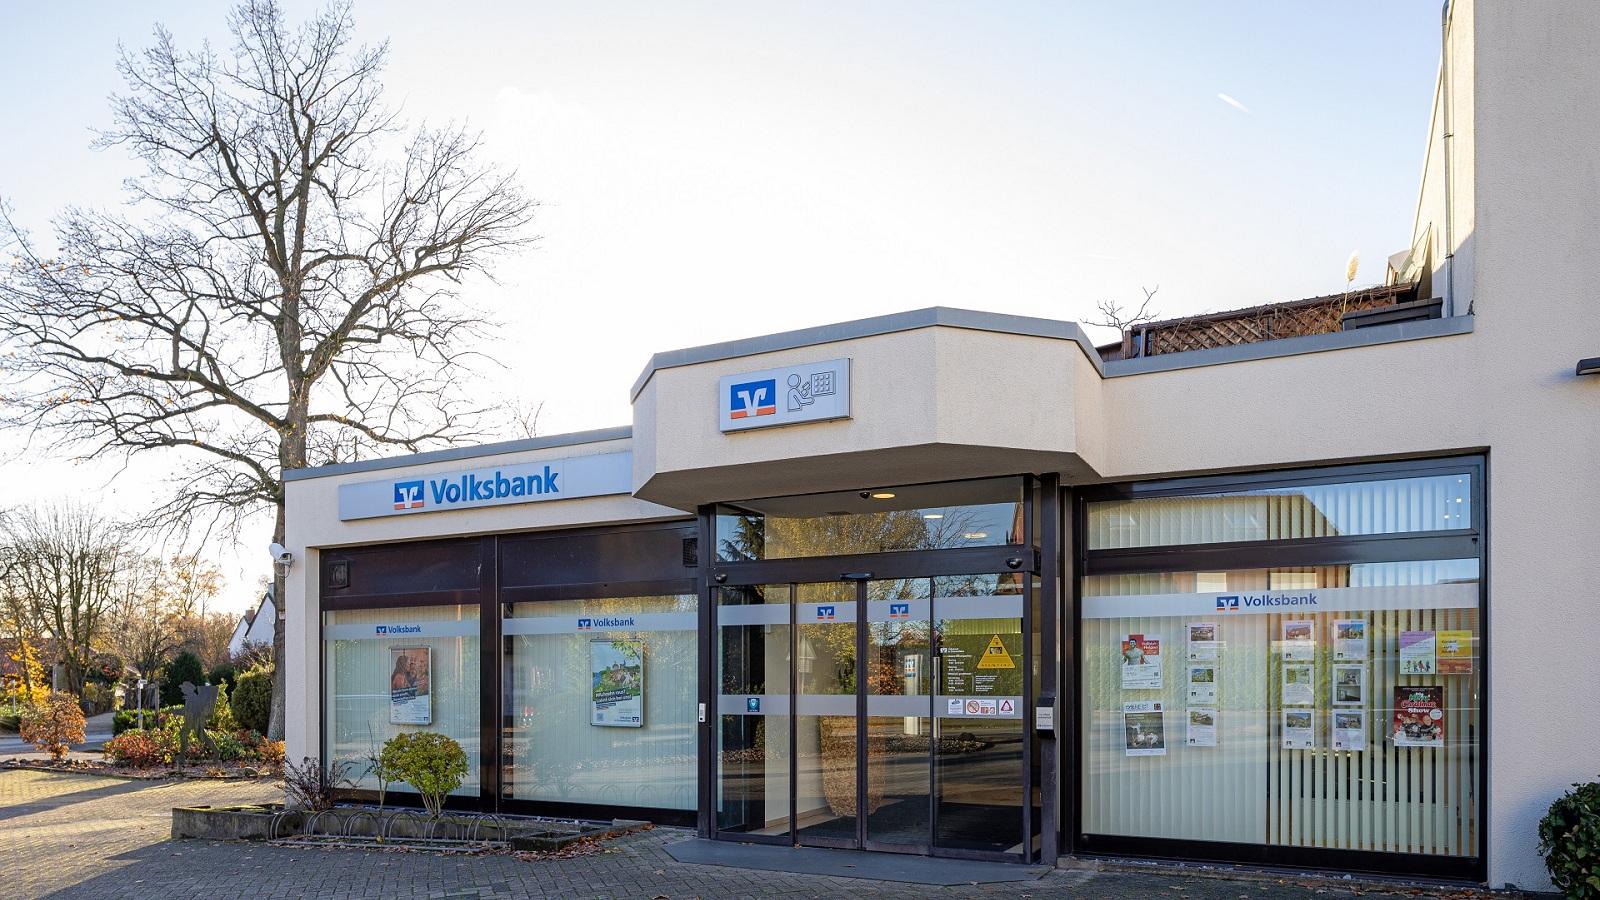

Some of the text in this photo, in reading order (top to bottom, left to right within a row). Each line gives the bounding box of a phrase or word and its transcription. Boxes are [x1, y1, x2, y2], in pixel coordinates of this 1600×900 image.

[430, 465, 559, 505] Volksbank
[1243, 592, 1318, 607] Volksbank
[592, 617, 634, 627] Volksbank
[388, 625, 421, 634] Volksbank
